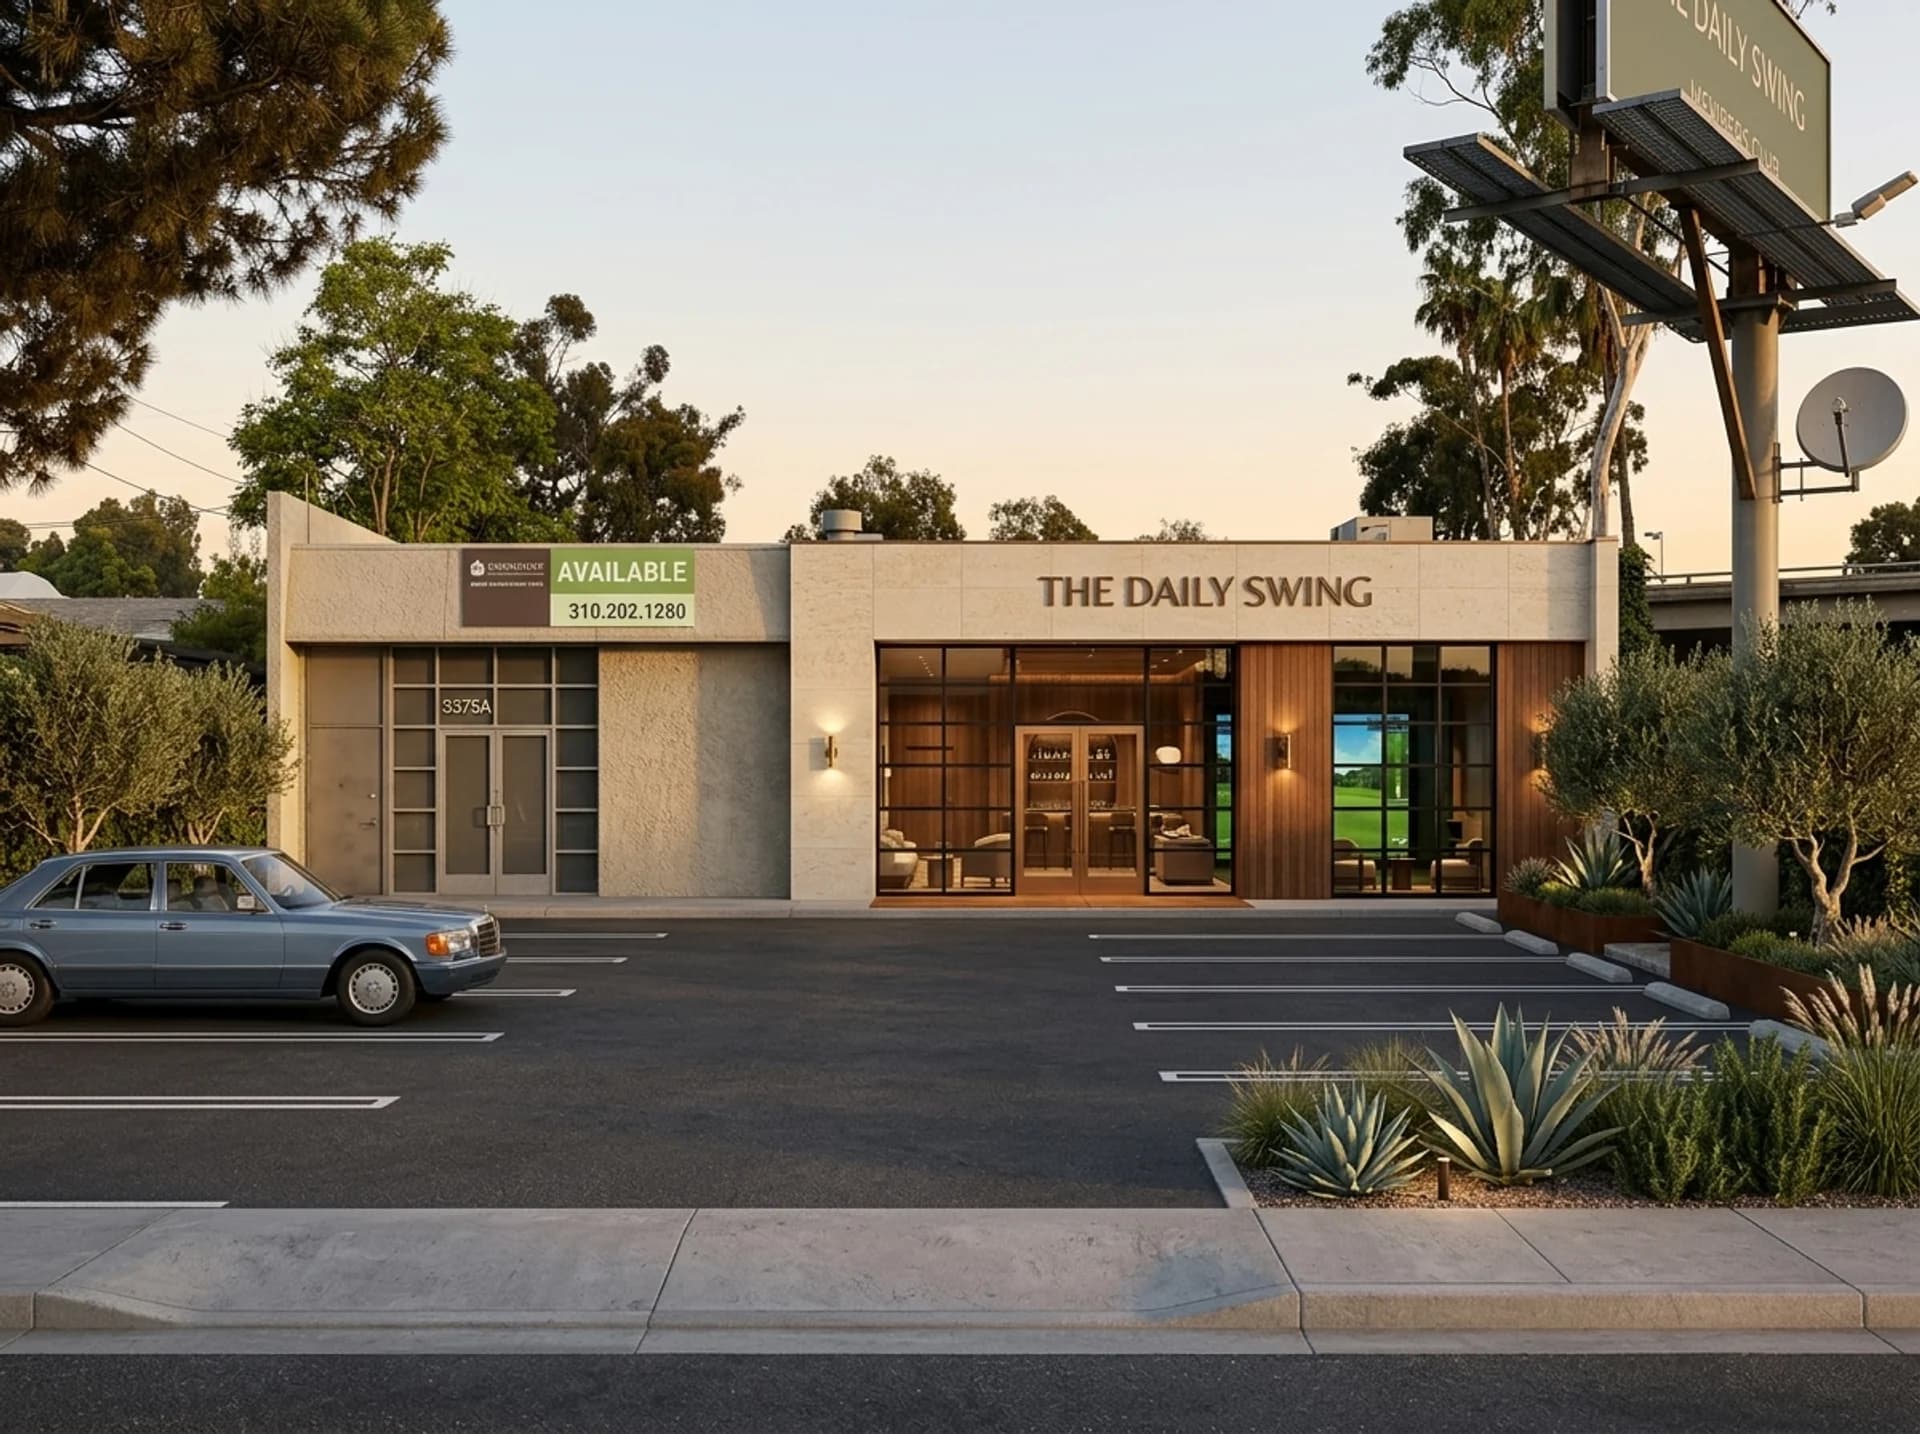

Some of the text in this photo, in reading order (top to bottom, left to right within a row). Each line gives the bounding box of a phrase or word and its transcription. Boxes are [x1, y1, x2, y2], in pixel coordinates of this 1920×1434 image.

[1694, 0, 1805, 131] DAILY SWING
[557, 561, 688, 582] AVAILABLE
[1037, 576, 1373, 607] THE DAILY SWING
[568, 602, 687, 620] 310.202.1280
[442, 698, 492, 715] 3375A
